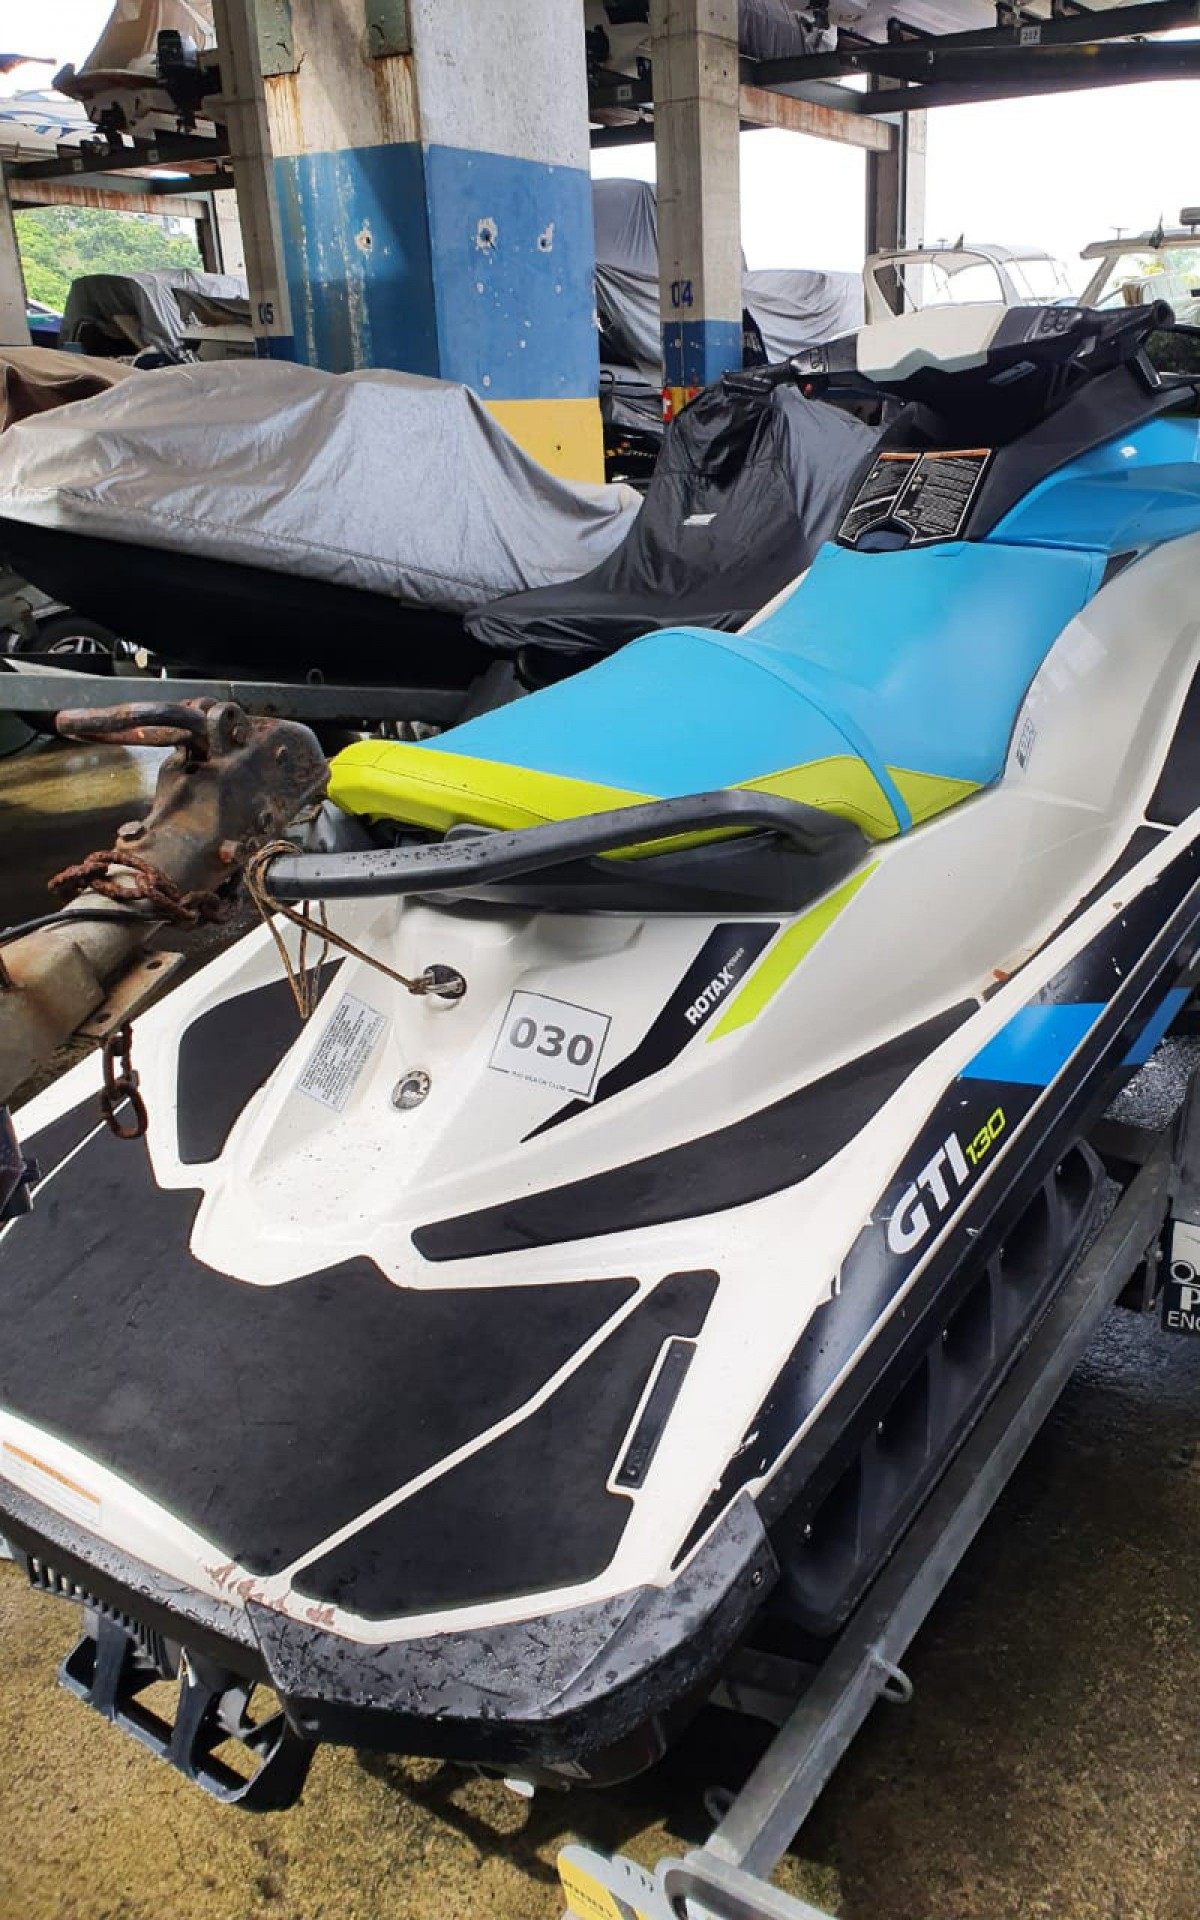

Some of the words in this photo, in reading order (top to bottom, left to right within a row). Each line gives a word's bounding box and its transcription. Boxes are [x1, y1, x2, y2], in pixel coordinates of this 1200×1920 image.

[671, 279, 694, 307] 04
[684, 966, 734, 1026] ROTAX
[509, 1016, 594, 1066] 030
[888, 1131, 970, 1254] GTI
[965, 1106, 1006, 1165] 130
